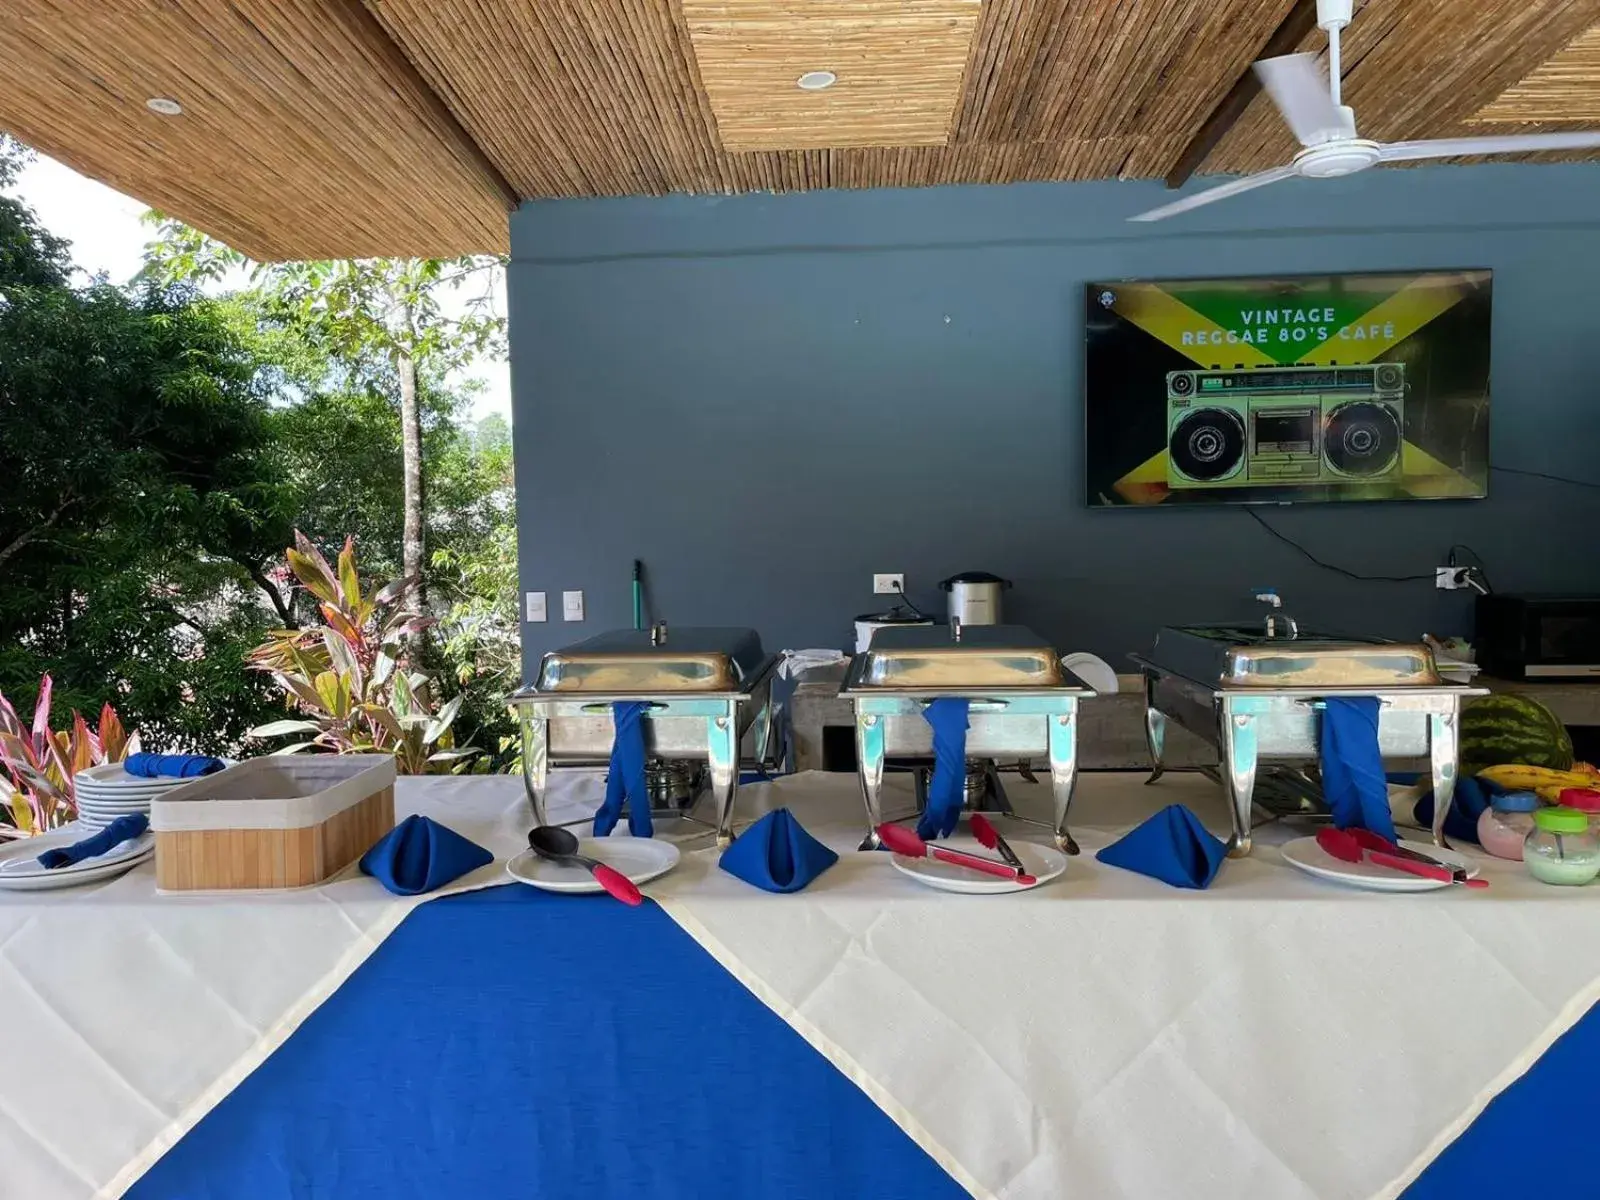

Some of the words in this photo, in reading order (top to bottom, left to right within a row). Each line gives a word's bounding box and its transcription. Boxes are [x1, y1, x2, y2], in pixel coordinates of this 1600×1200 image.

[1241, 308, 1335, 325] VINTAGE
[1181, 328, 1269, 345] REGGAE
[1278, 326, 1328, 342] 80'S
[1338, 321, 1395, 340] CAFÉ
